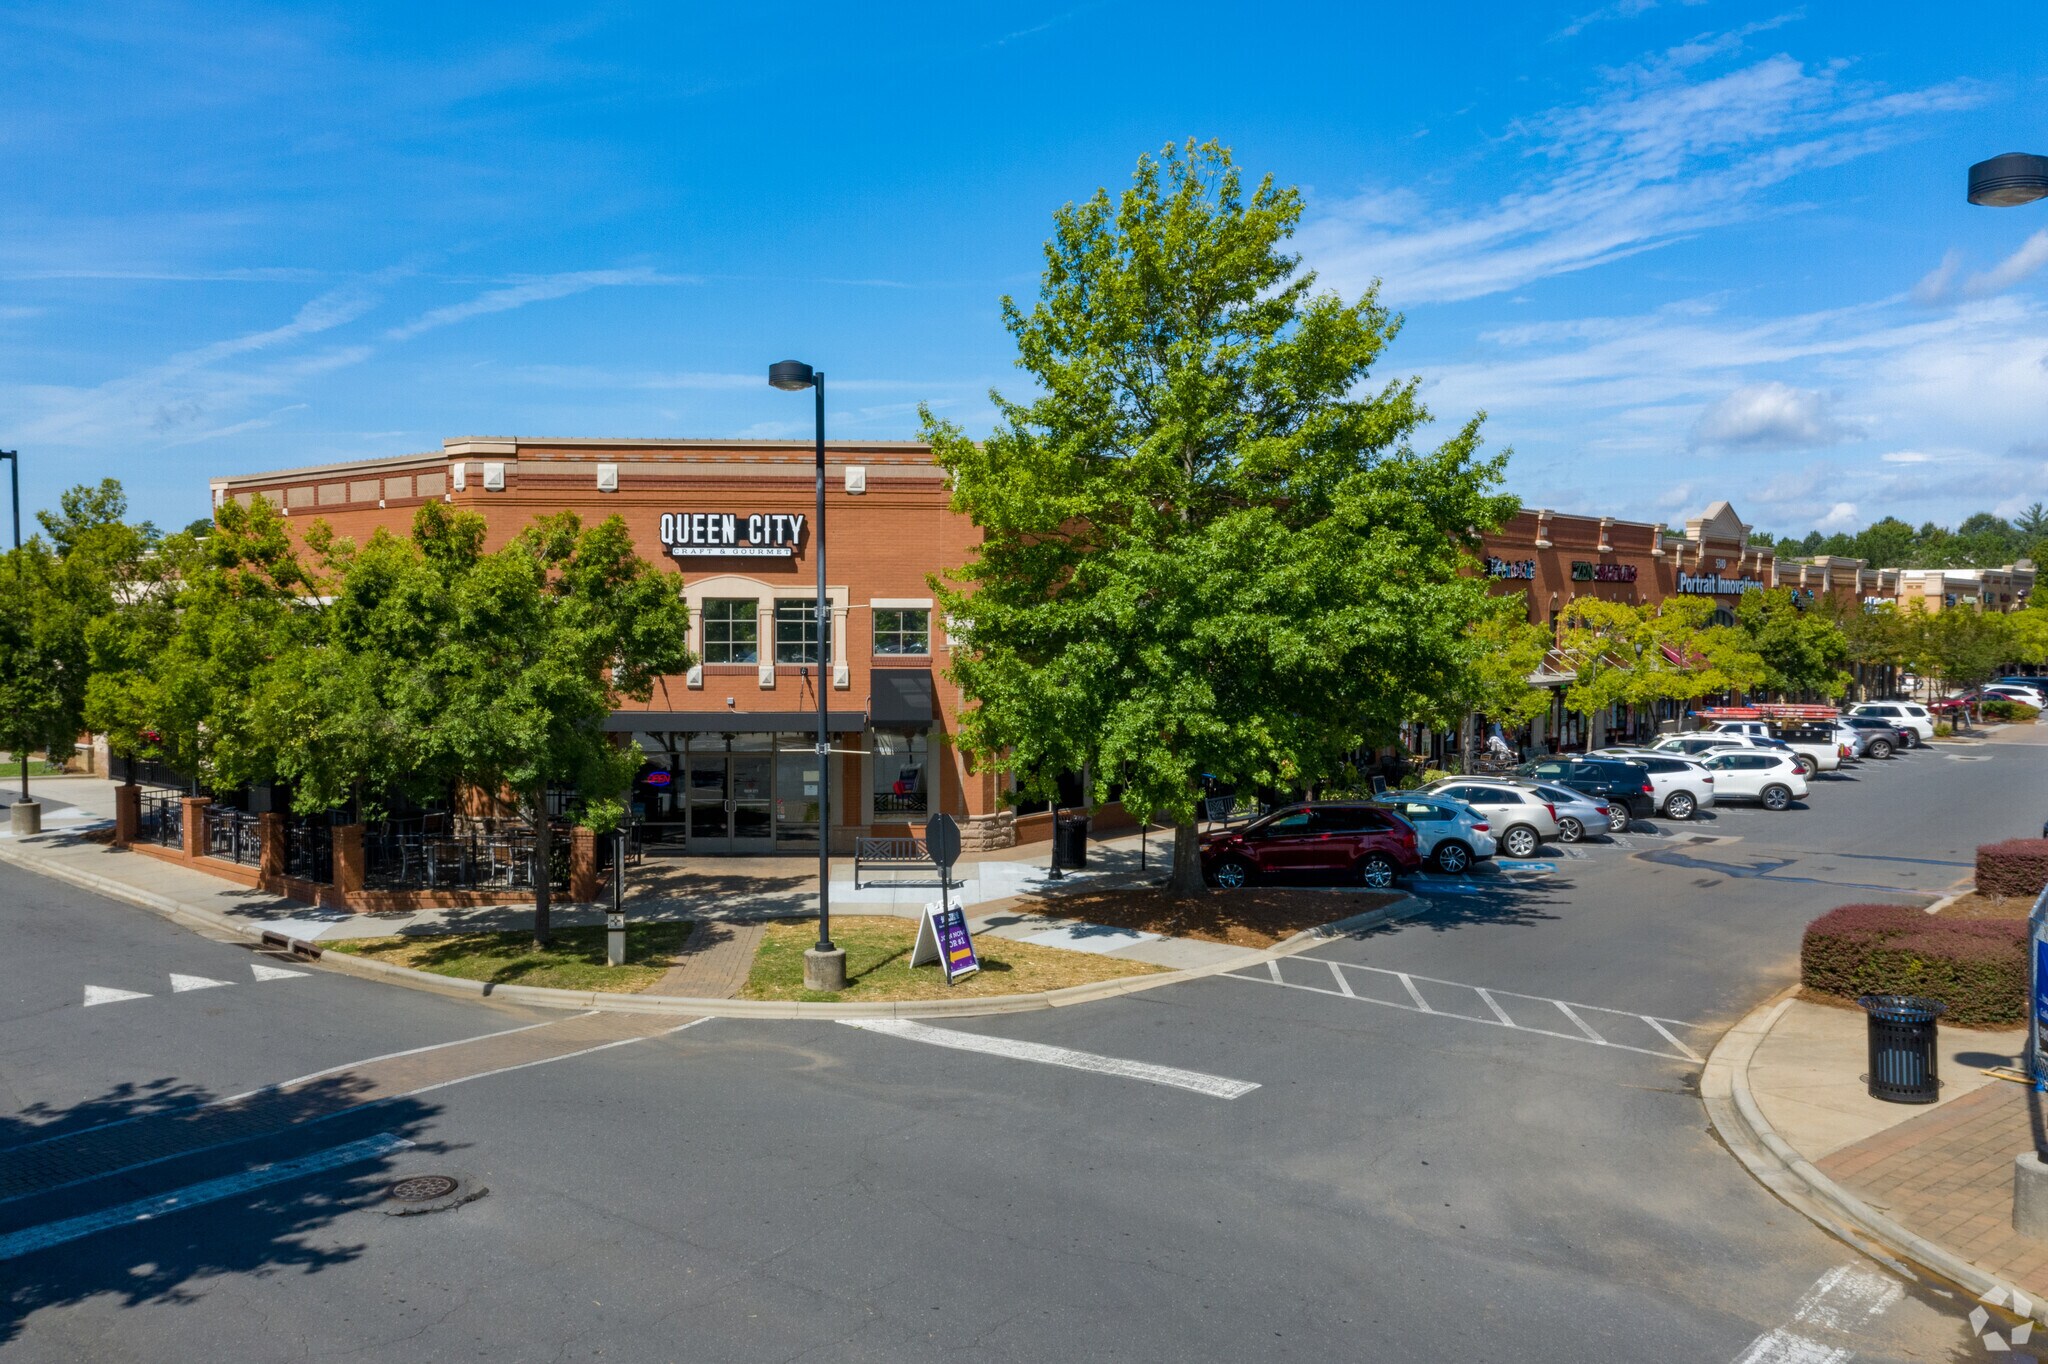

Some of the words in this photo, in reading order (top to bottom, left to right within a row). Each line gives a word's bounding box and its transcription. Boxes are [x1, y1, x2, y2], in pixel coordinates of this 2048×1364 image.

[660, 514, 736, 545] QUEEN
[749, 514, 804, 545] CITY
[732, 548, 791, 556] GOURMET
[1680, 571, 1716, 595] Portrait
[647, 774, 671, 783] OPEN
